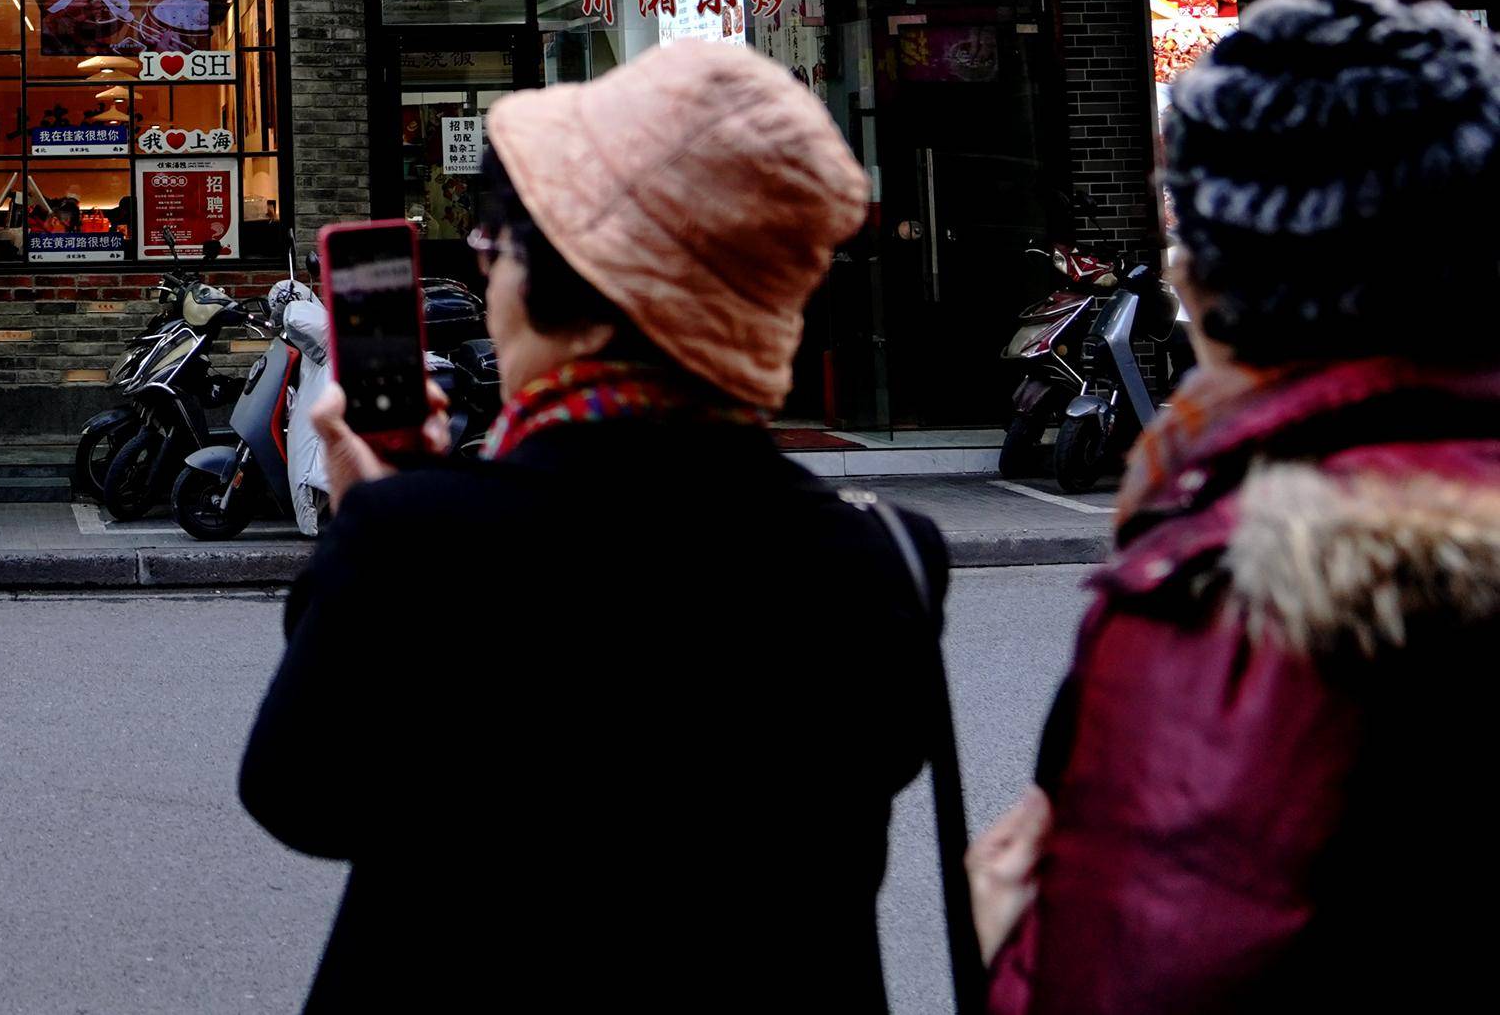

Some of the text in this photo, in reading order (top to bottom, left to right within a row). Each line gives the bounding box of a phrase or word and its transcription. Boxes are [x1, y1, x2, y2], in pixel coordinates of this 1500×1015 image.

[143, 54, 231, 77] I SH
[449, 120, 475, 132] 招聘
[39, 129, 119, 142] 我在佳家很想你
[142, 132, 231, 150] 我 上海
[205, 175, 224, 214] 招聘
[30, 236, 122, 249] 我在黄河路很想你
